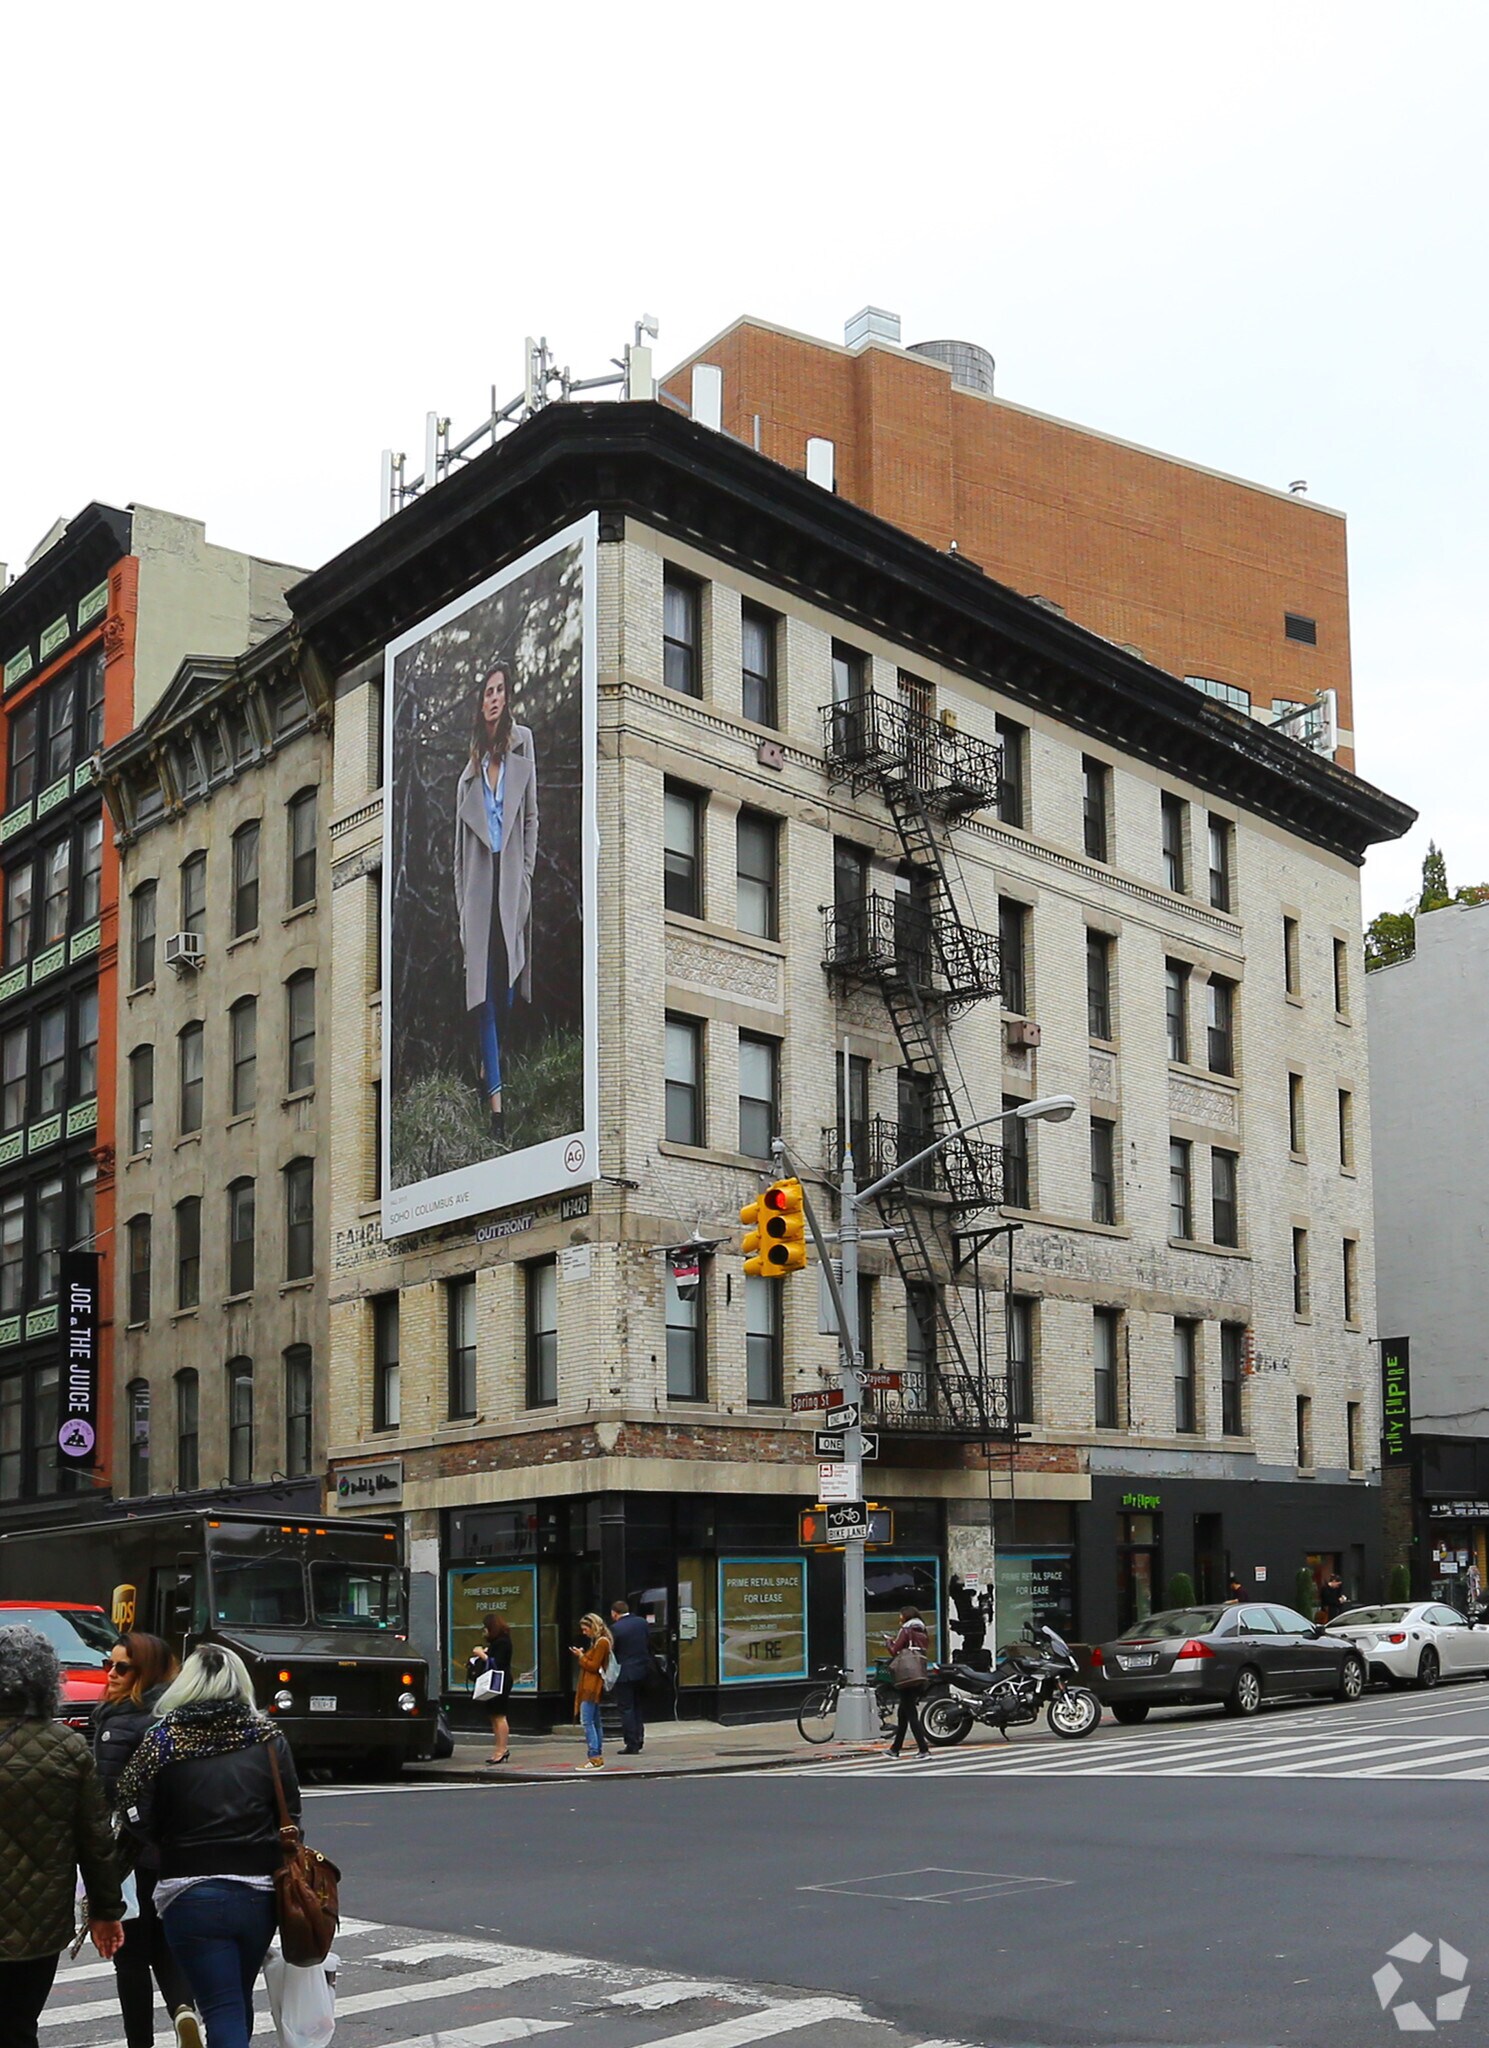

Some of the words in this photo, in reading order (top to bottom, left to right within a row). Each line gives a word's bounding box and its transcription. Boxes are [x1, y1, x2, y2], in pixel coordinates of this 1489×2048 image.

[567, 1149, 582, 1164] AG
[389, 1212, 410, 1225] SOHO
[415, 1197, 454, 1217] COLUMBUS
[455, 1192, 470, 1207] AVE
[477, 1216, 533, 1241] OUTFRONT
[70, 1283, 91, 1314] JOE
[70, 1327, 91, 1359] THE
[69, 1364, 91, 1412] JUICE
[1385, 1356, 1406, 1415] EMPIRE
[793, 1395, 819, 1411] Spring
[821, 1393, 830, 1407] St
[830, 1414, 840, 1424] ONE
[843, 1411, 854, 1421] WAY
[823, 1439, 843, 1449] ONE
[829, 1529, 845, 1540] BIKE
[847, 1526, 866, 1538] LANE
[727, 1578, 749, 1588] PRIME
[750, 1577, 775, 1587] RETAIL
[776, 1577, 799, 1587] SPACE
[1021, 1572, 1043, 1581] RETAIL
[1043, 1571, 1063, 1581] SPACE
[464, 1587, 481, 1597] PRIME
[482, 1586, 500, 1595] RETAIL
[501, 1586, 520, 1595] SPACE
[1015, 1586, 1029, 1595] FOR
[1029, 1585, 1049, 1595] LEASE
[744, 1594, 758, 1603] FOR
[759, 1593, 783, 1603] LEASE
[476, 1602, 488, 1611] FOR
[489, 1601, 507, 1610] LEASE
